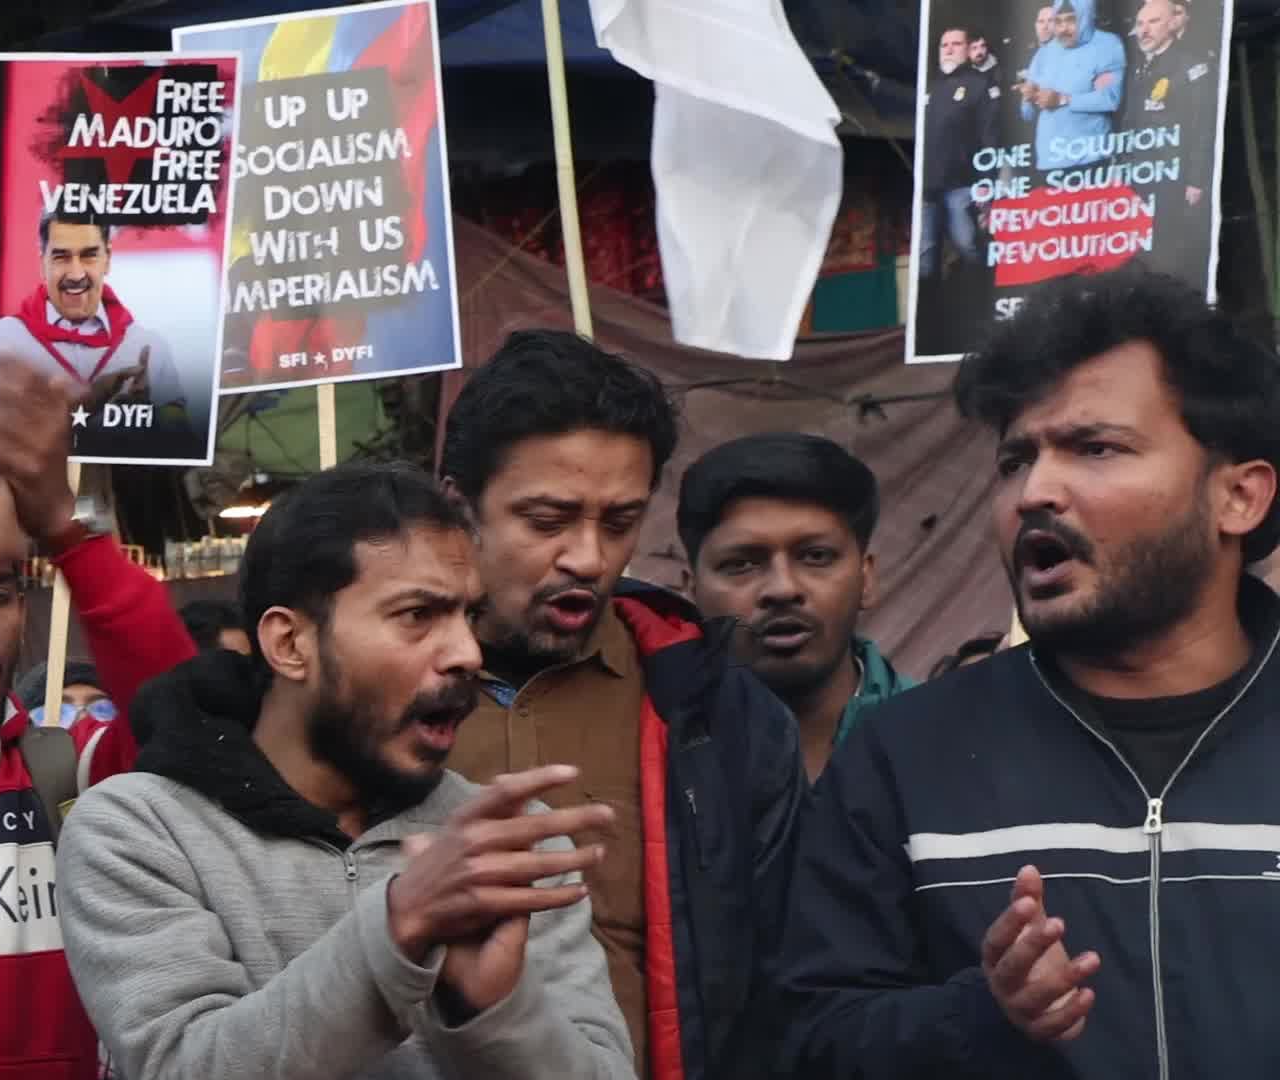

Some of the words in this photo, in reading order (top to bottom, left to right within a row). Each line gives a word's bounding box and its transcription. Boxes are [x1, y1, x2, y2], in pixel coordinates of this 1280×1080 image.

[156, 78, 226, 115] FREE
[263, 96, 307, 129] UP
[326, 87, 369, 121] UP
[68, 113, 223, 148] MADURO
[972, 143, 1032, 172] ONE
[1048, 124, 1181, 163] SOLUTION
[151, 146, 221, 182] FREE
[235, 128, 412, 178] SOCIALISM
[39, 180, 217, 215] VENEZUELA
[263, 176, 384, 220] DOWN
[970, 175, 1032, 203] ONE
[1045, 157, 1180, 195] SOLUTION
[990, 194, 1156, 234] REVOLUTION
[250, 227, 339, 265] WITH
[359, 215, 405, 253] US
[986, 228, 1153, 267] REVOLUTION
[995, 296, 1025, 321] SF
[278, 354, 308, 369] SFI
[331, 346, 374, 362] DYFI
[102, 402, 154, 429] DYFI
